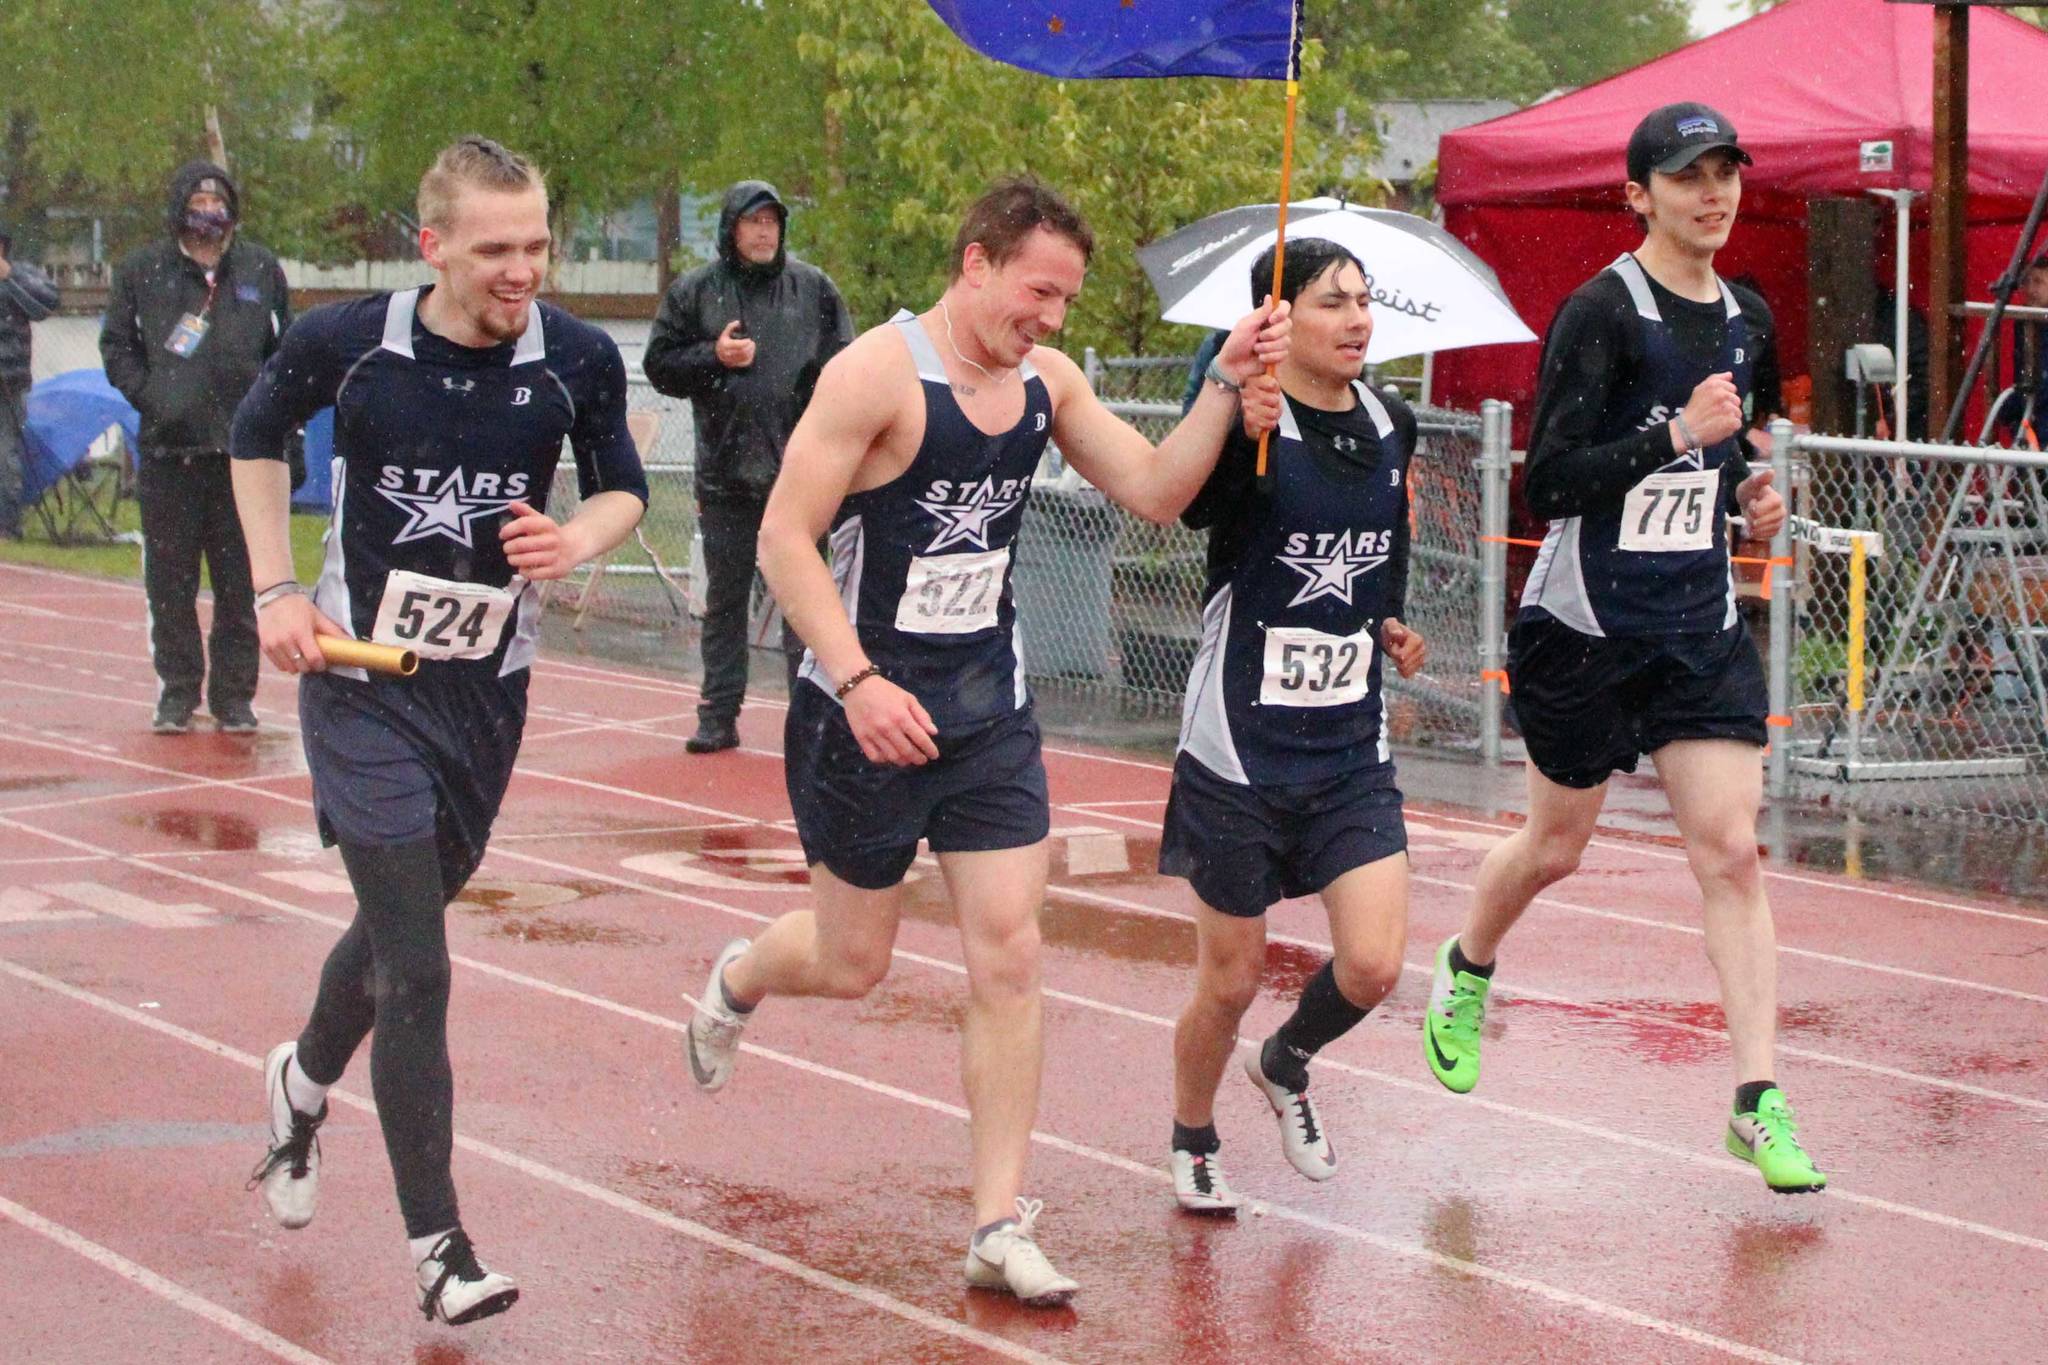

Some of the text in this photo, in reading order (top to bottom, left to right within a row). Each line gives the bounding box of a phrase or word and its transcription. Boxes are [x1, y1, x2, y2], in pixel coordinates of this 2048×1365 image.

[380, 464, 530, 498] STARS
[1638, 487, 1706, 535] 775
[1284, 528, 1393, 558] STARS
[394, 590, 490, 648] 524
[1280, 642, 1359, 692] 532
